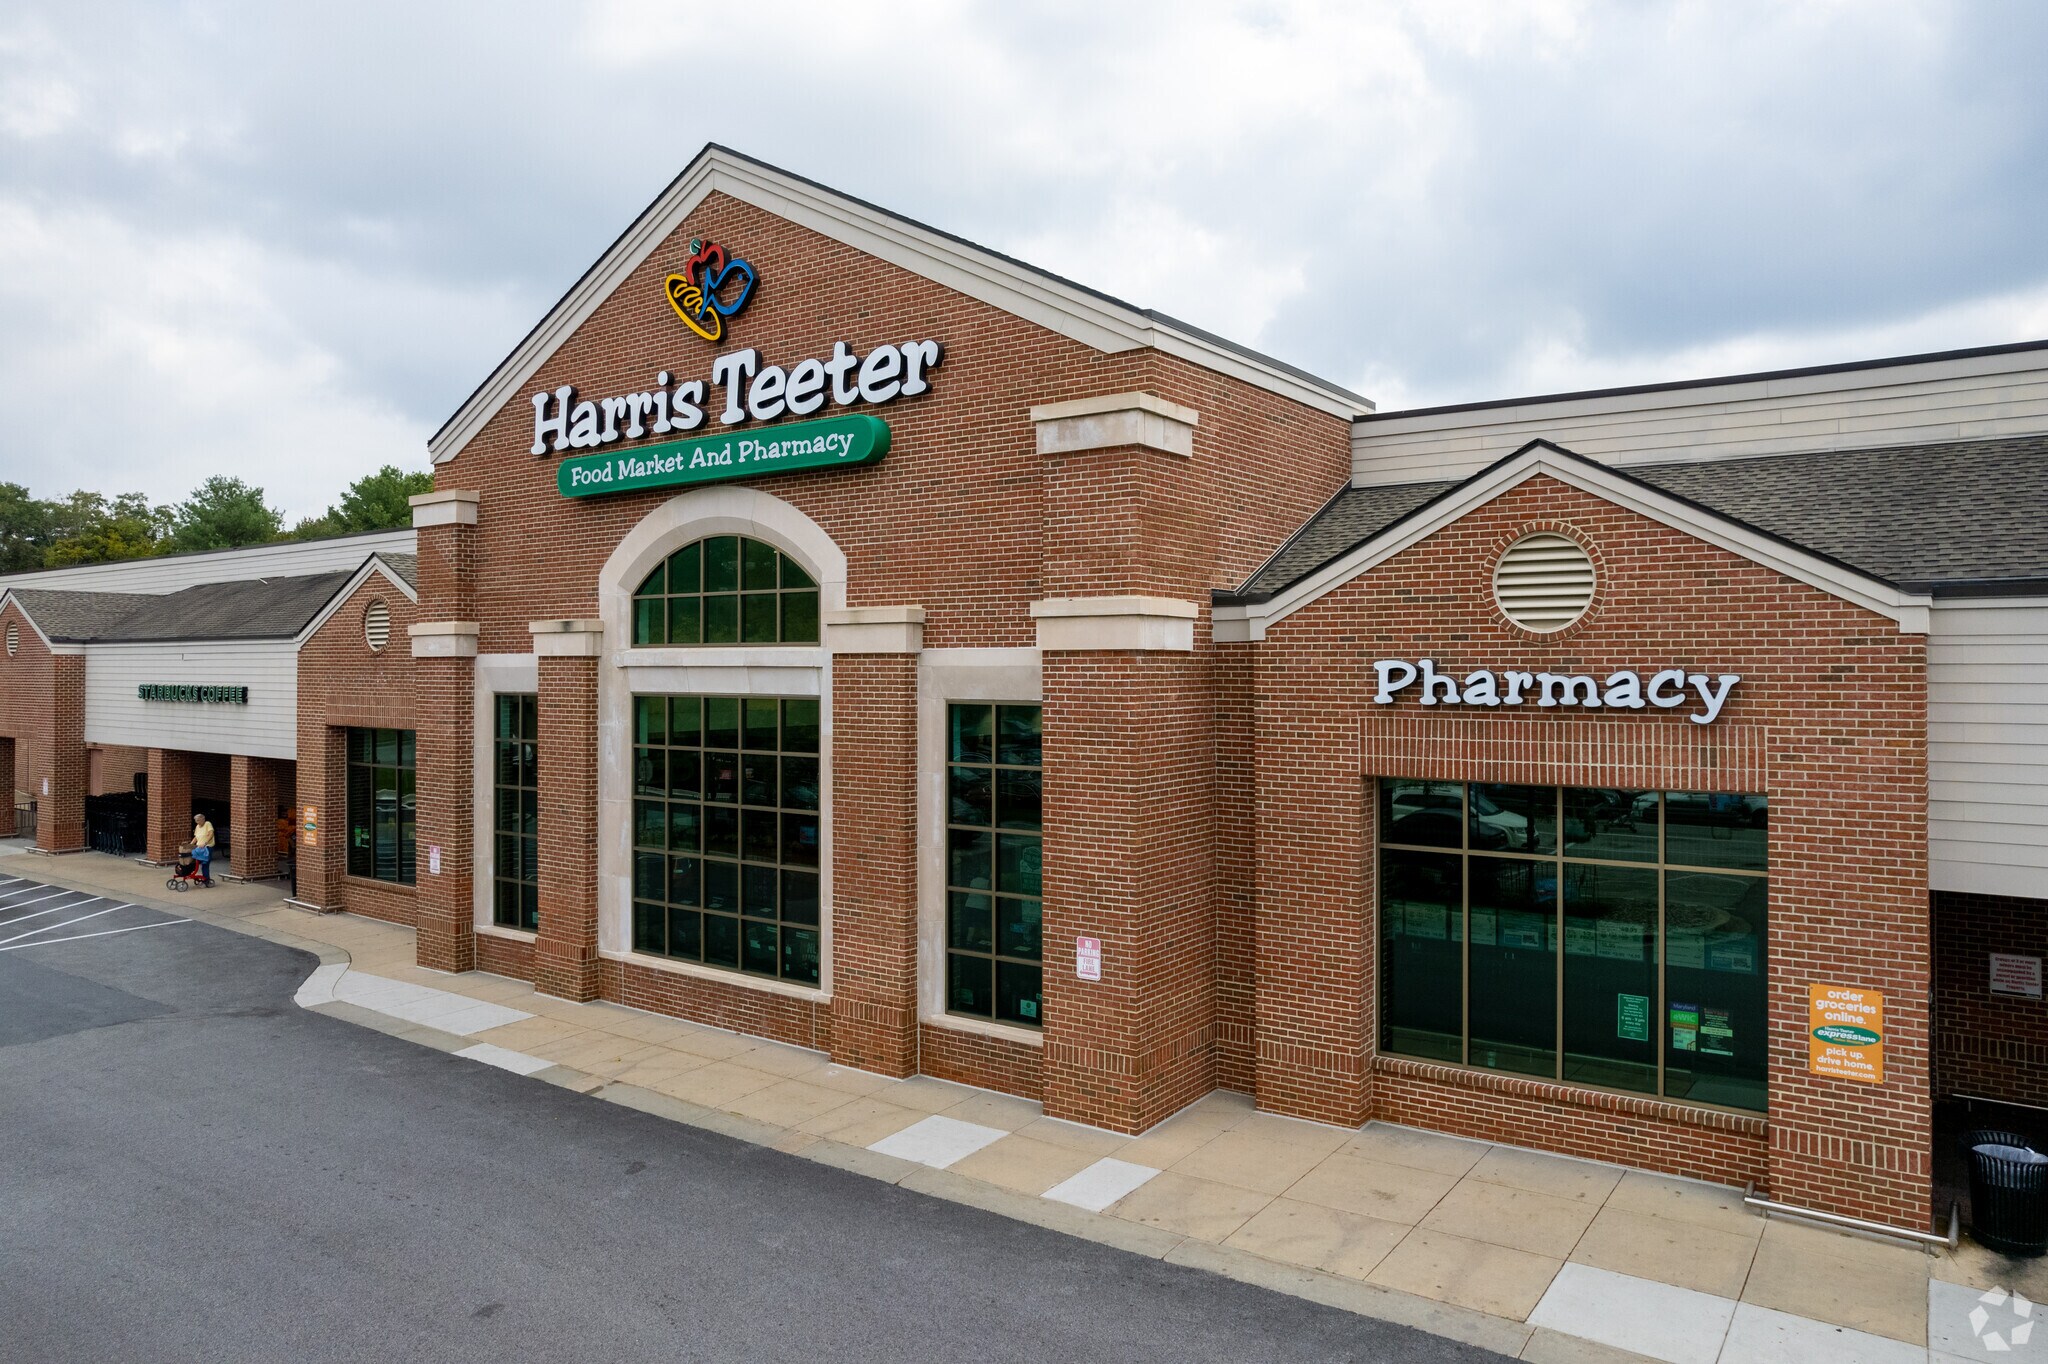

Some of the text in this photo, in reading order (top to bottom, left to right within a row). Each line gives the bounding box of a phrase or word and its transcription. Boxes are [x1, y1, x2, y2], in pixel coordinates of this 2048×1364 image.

[530, 340, 942, 456] Harris Teeter
[571, 431, 855, 487] Food Market And Pharmacy
[138, 684, 246, 703] STARBUCKS COFFEE
[1373, 658, 1741, 724] Pharmacy
[1827, 990, 1864, 1002] order
[1815, 999, 1877, 1014] groceries
[1824, 1012, 1867, 1024] online.
[1826, 1047, 1865, 1060] pick up.
[1817, 1056, 1875, 1071] drive home.
